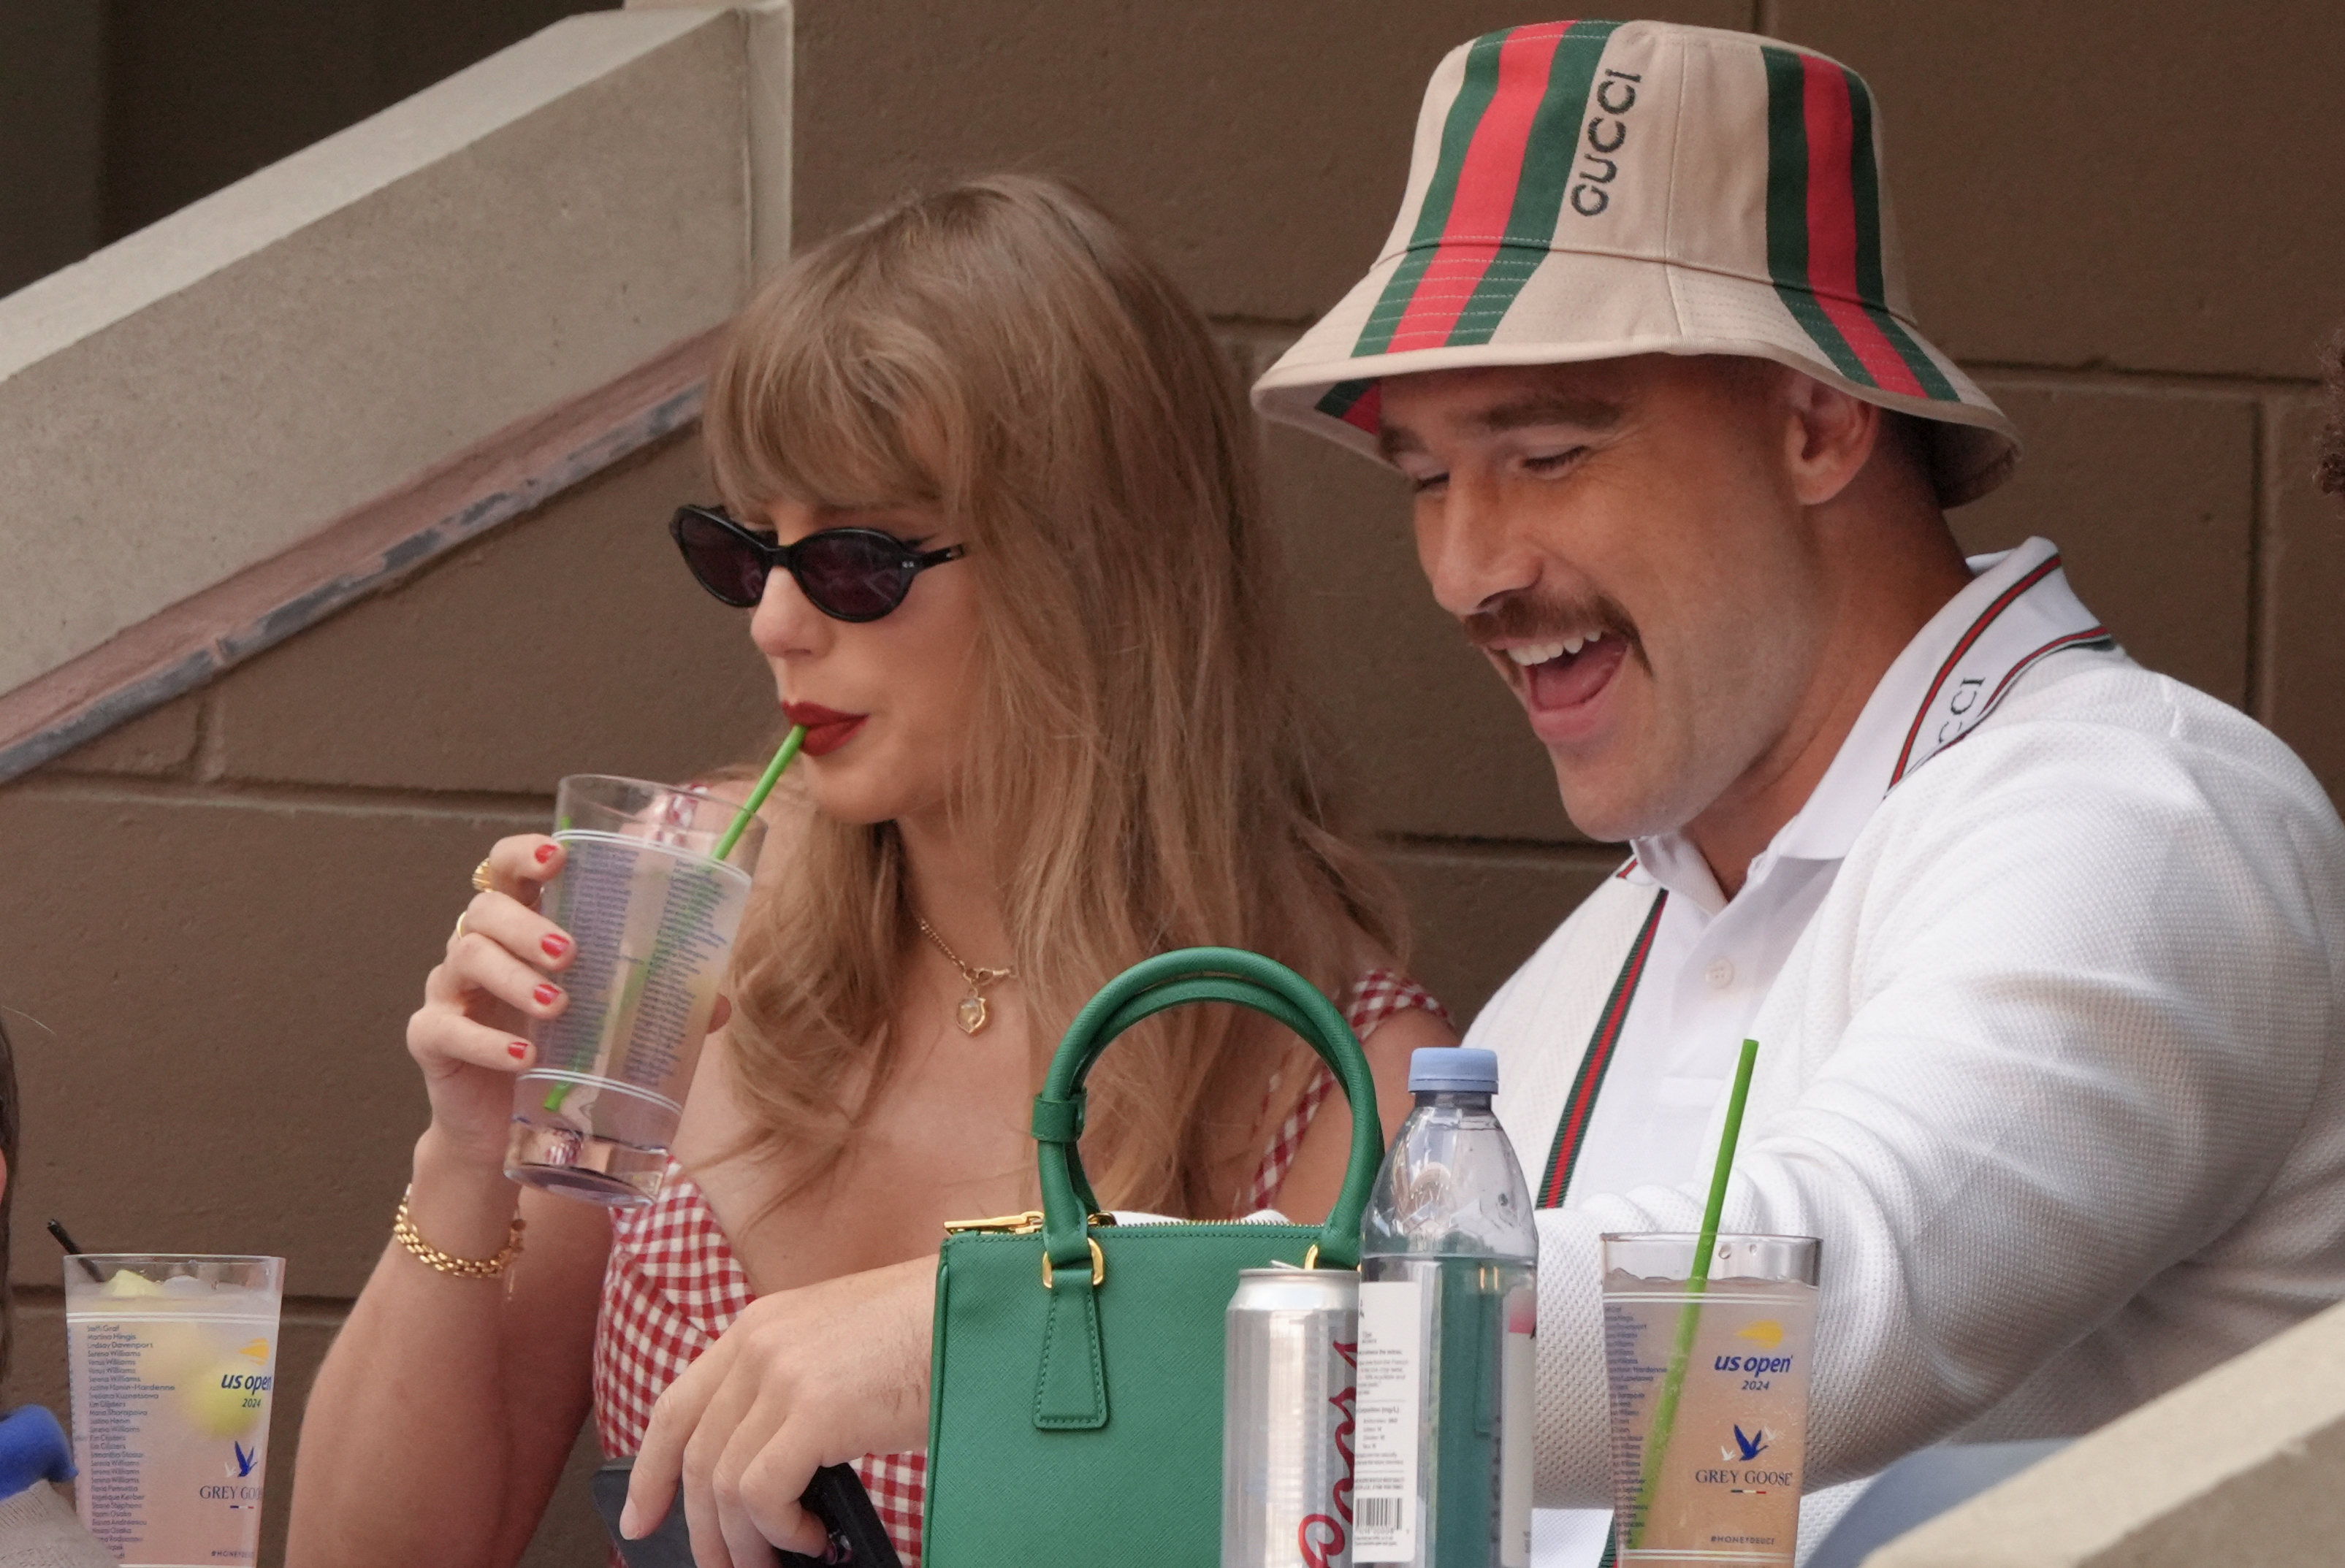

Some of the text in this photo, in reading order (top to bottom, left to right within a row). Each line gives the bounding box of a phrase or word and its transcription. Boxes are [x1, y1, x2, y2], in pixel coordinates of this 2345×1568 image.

[1570, 68, 1642, 217] GUCCI
[1714, 1355, 1792, 1378] us open
[221, 1374, 272, 1395] us open
[1742, 1380, 1770, 1391] 2024
[242, 1398, 262, 1408] 2024
[1696, 1469, 1793, 1486] GREY GOOSE
[199, 1485, 238, 1499] GREY
